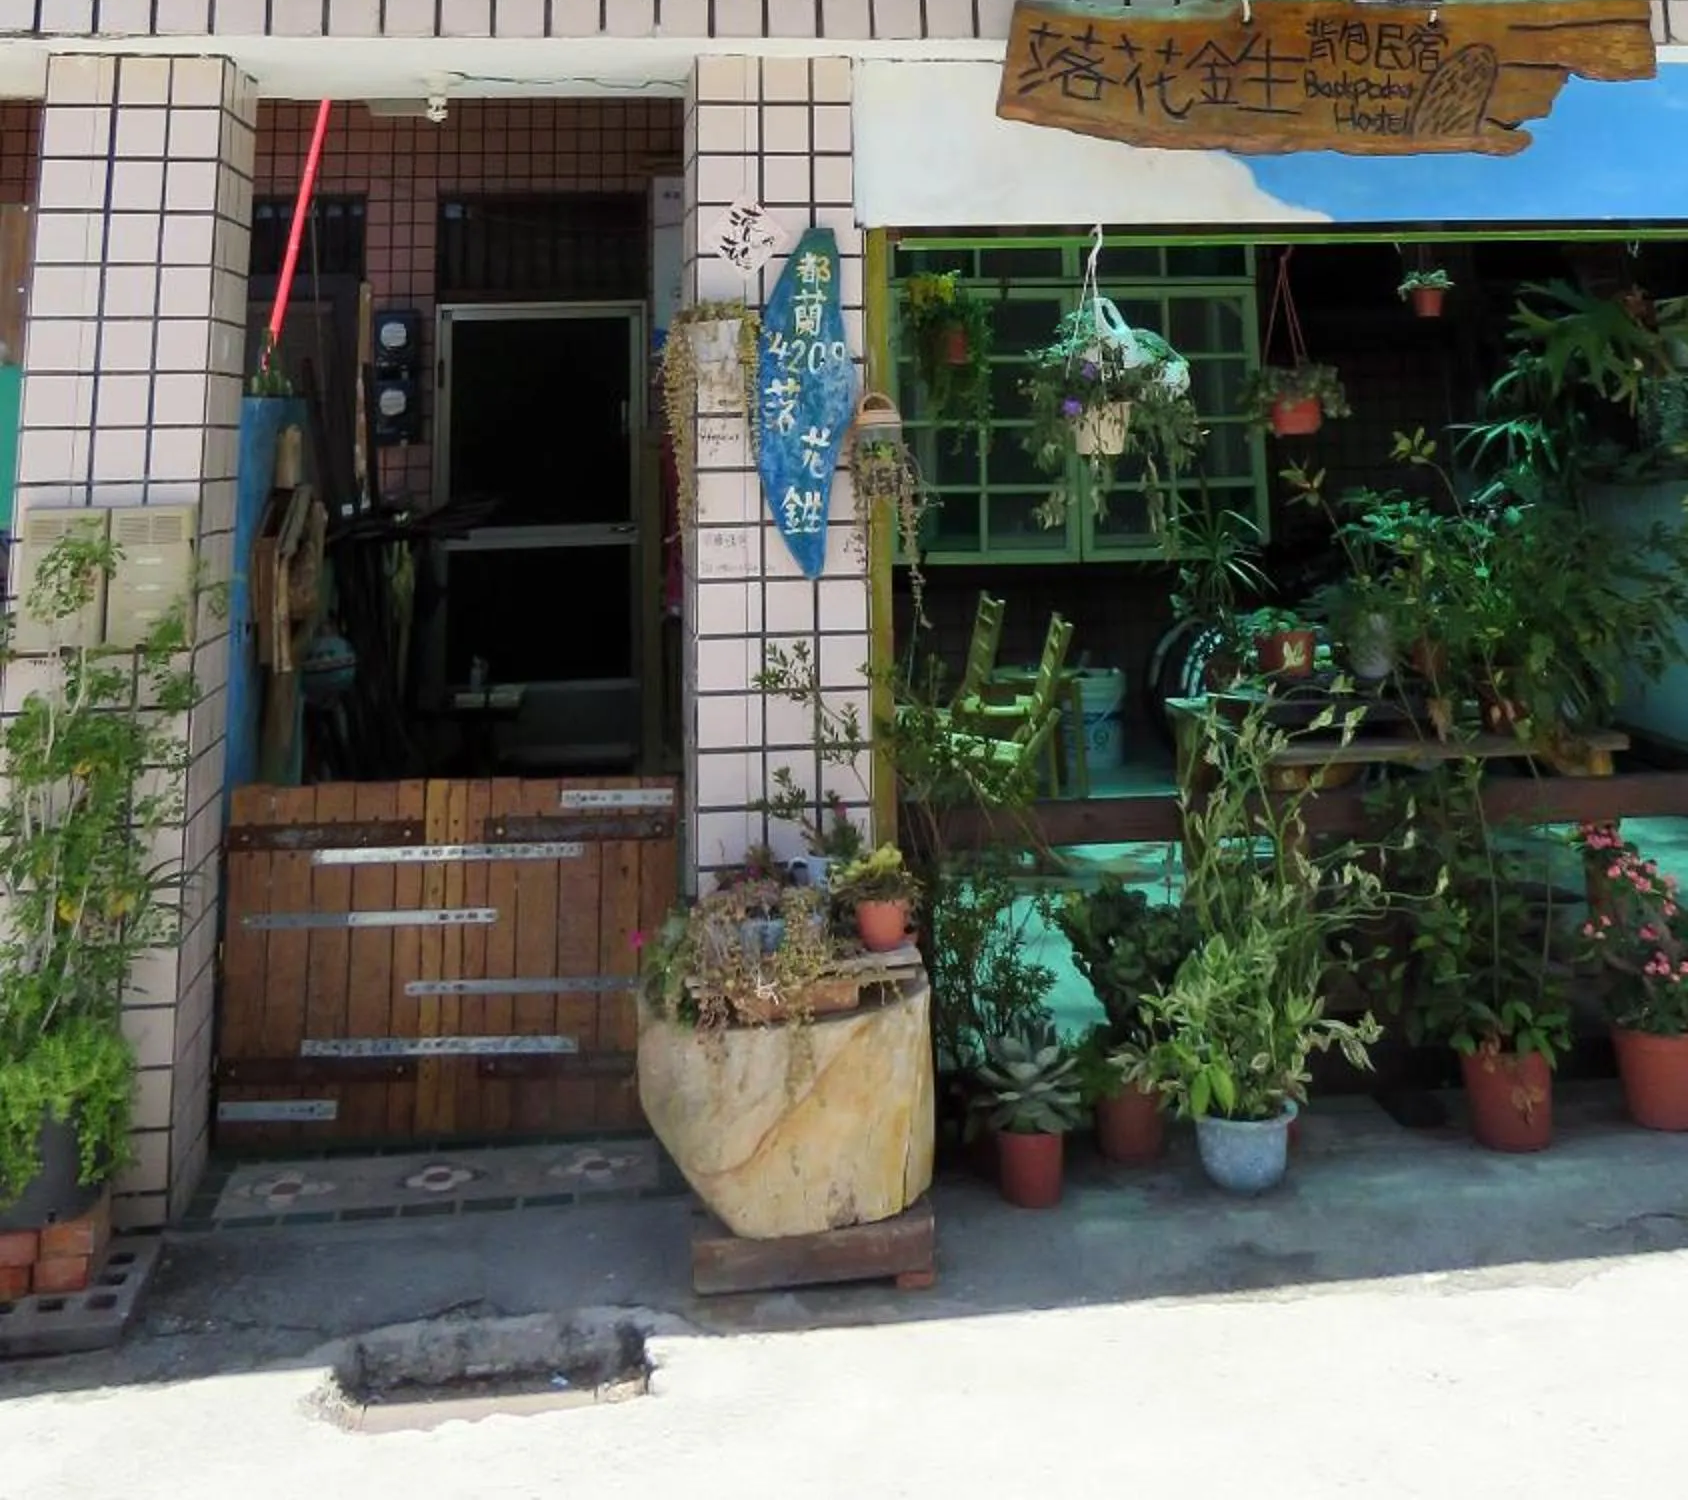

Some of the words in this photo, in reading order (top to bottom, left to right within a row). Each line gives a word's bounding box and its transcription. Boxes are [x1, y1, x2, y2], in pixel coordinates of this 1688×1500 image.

[1305, 18, 1449, 73] 背包民宿
[793, 251, 831, 336] 都蘭
